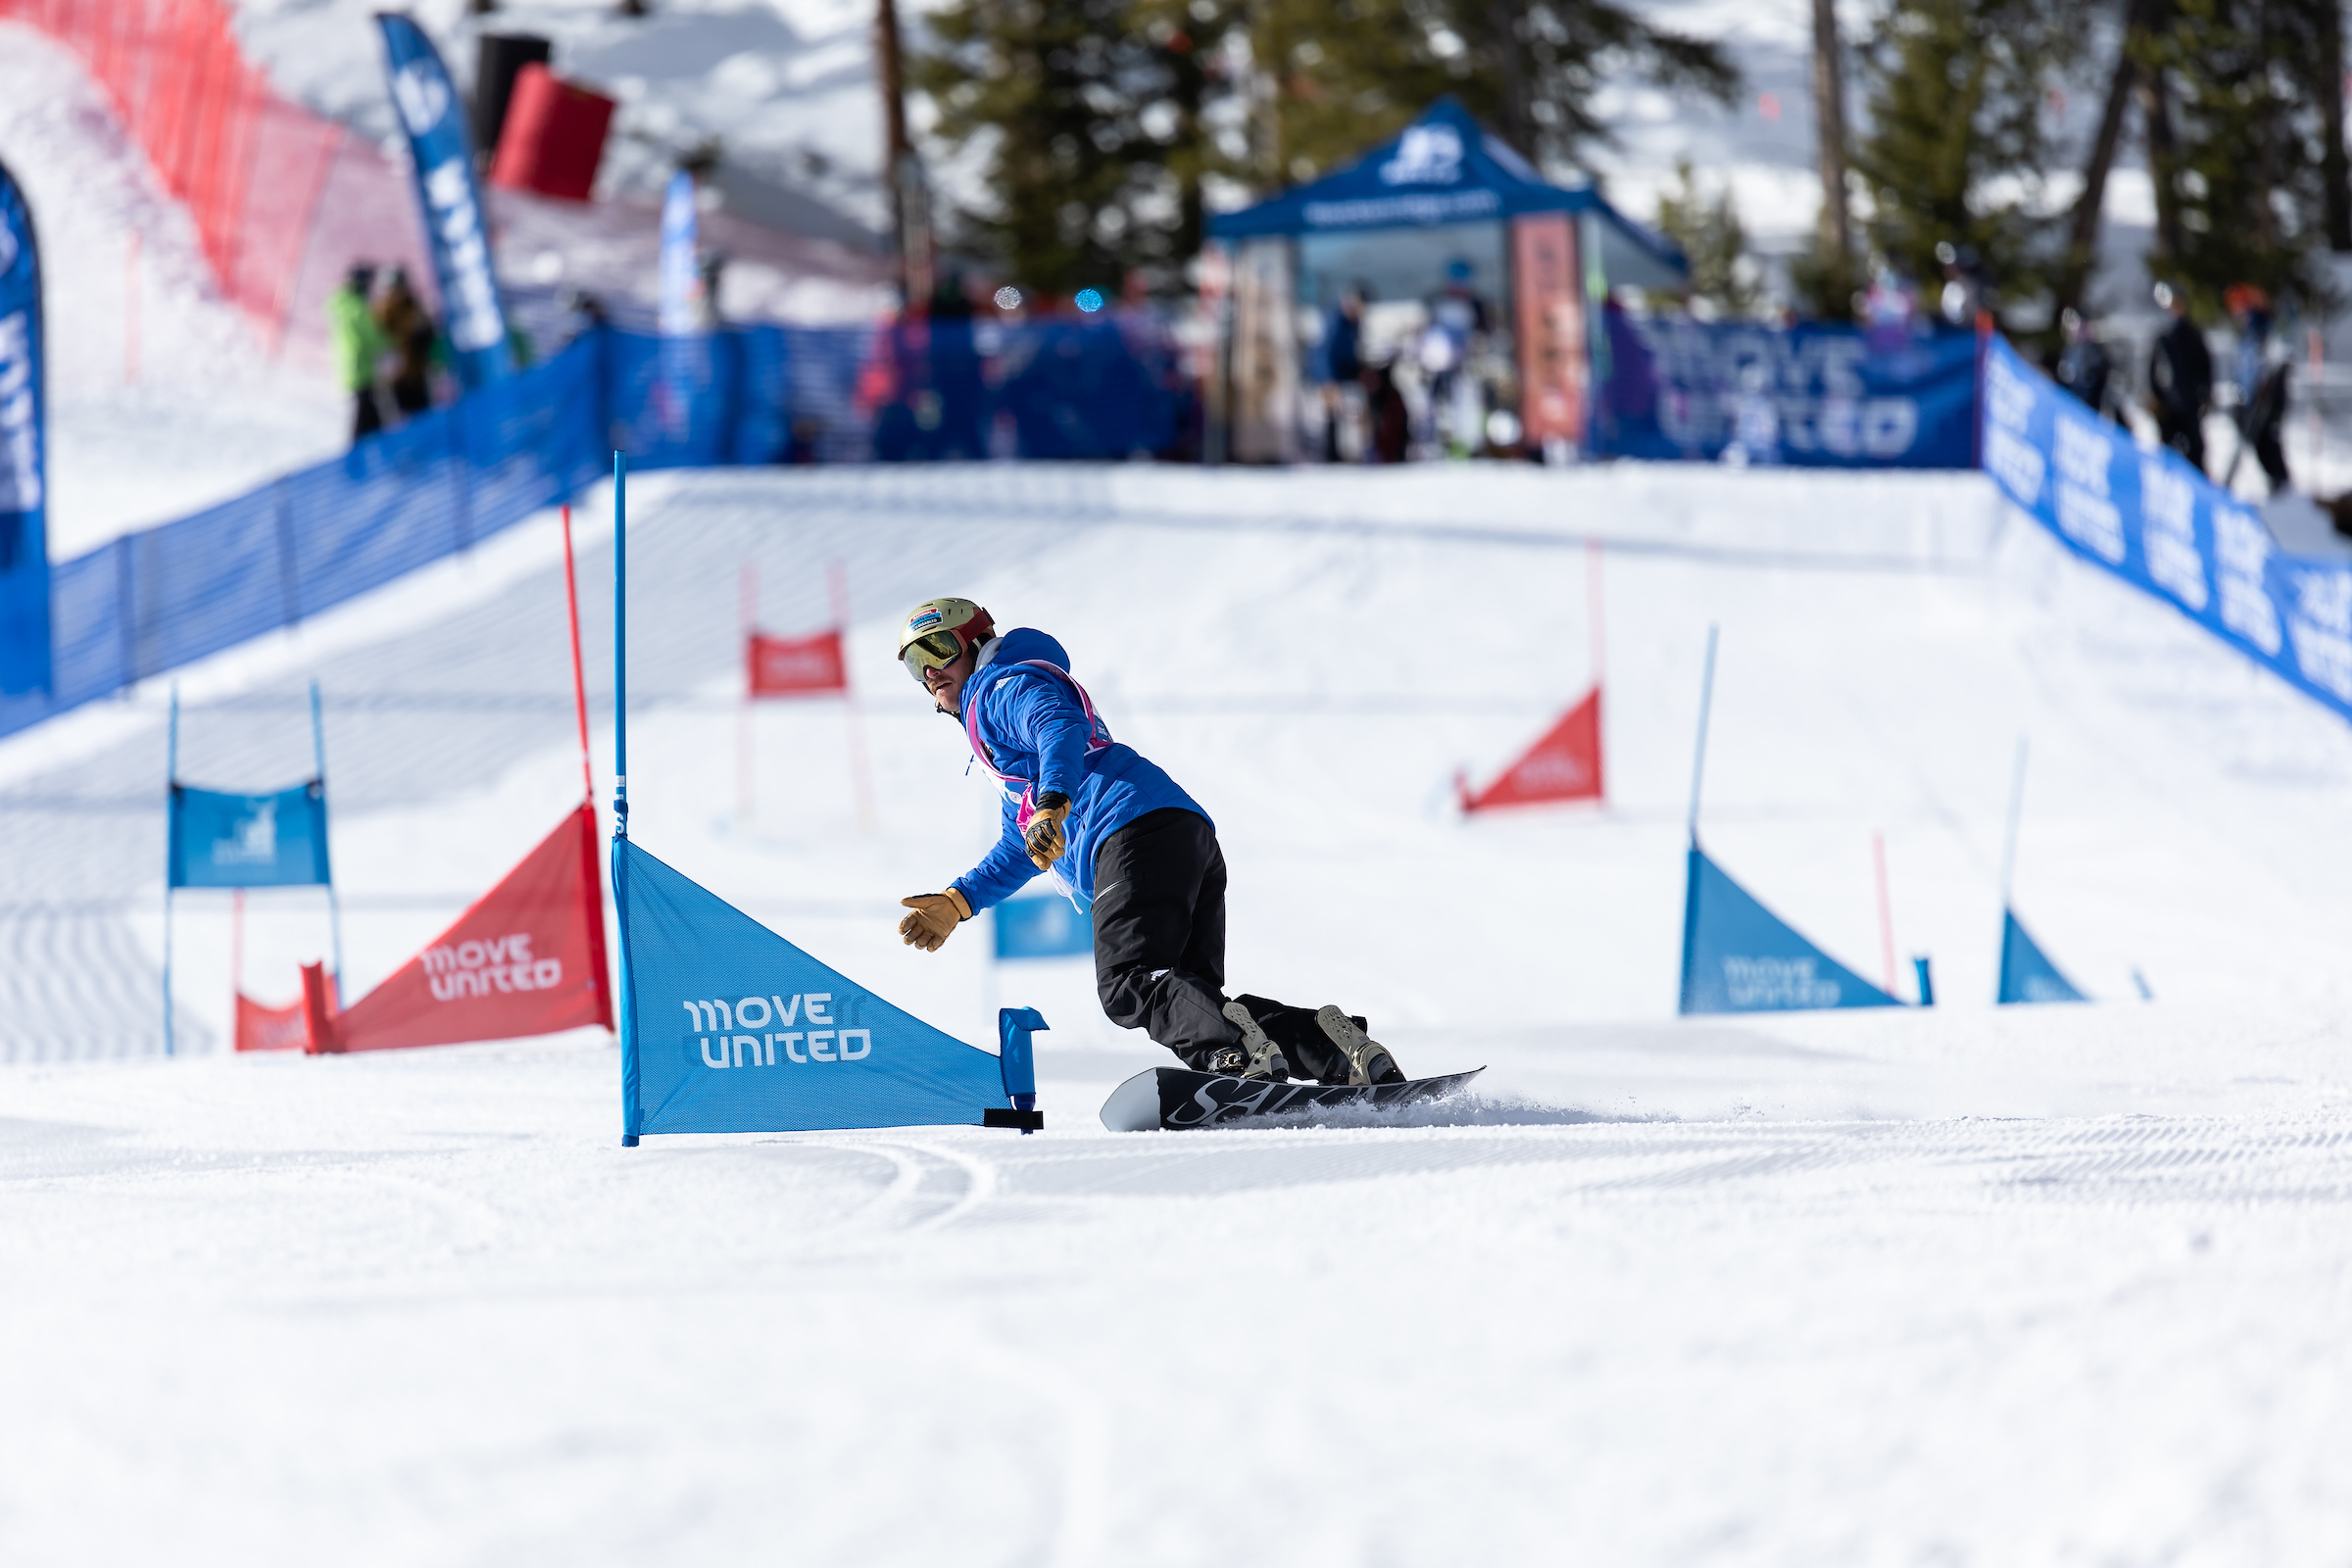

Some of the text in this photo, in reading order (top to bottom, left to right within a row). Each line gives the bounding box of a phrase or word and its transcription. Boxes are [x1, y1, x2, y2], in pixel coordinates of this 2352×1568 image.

[421, 933, 533, 973] MOVE
[430, 957, 563, 1001] UNITED
[683, 993, 834, 1032] MOVE
[701, 1029, 871, 1069] UNITED
